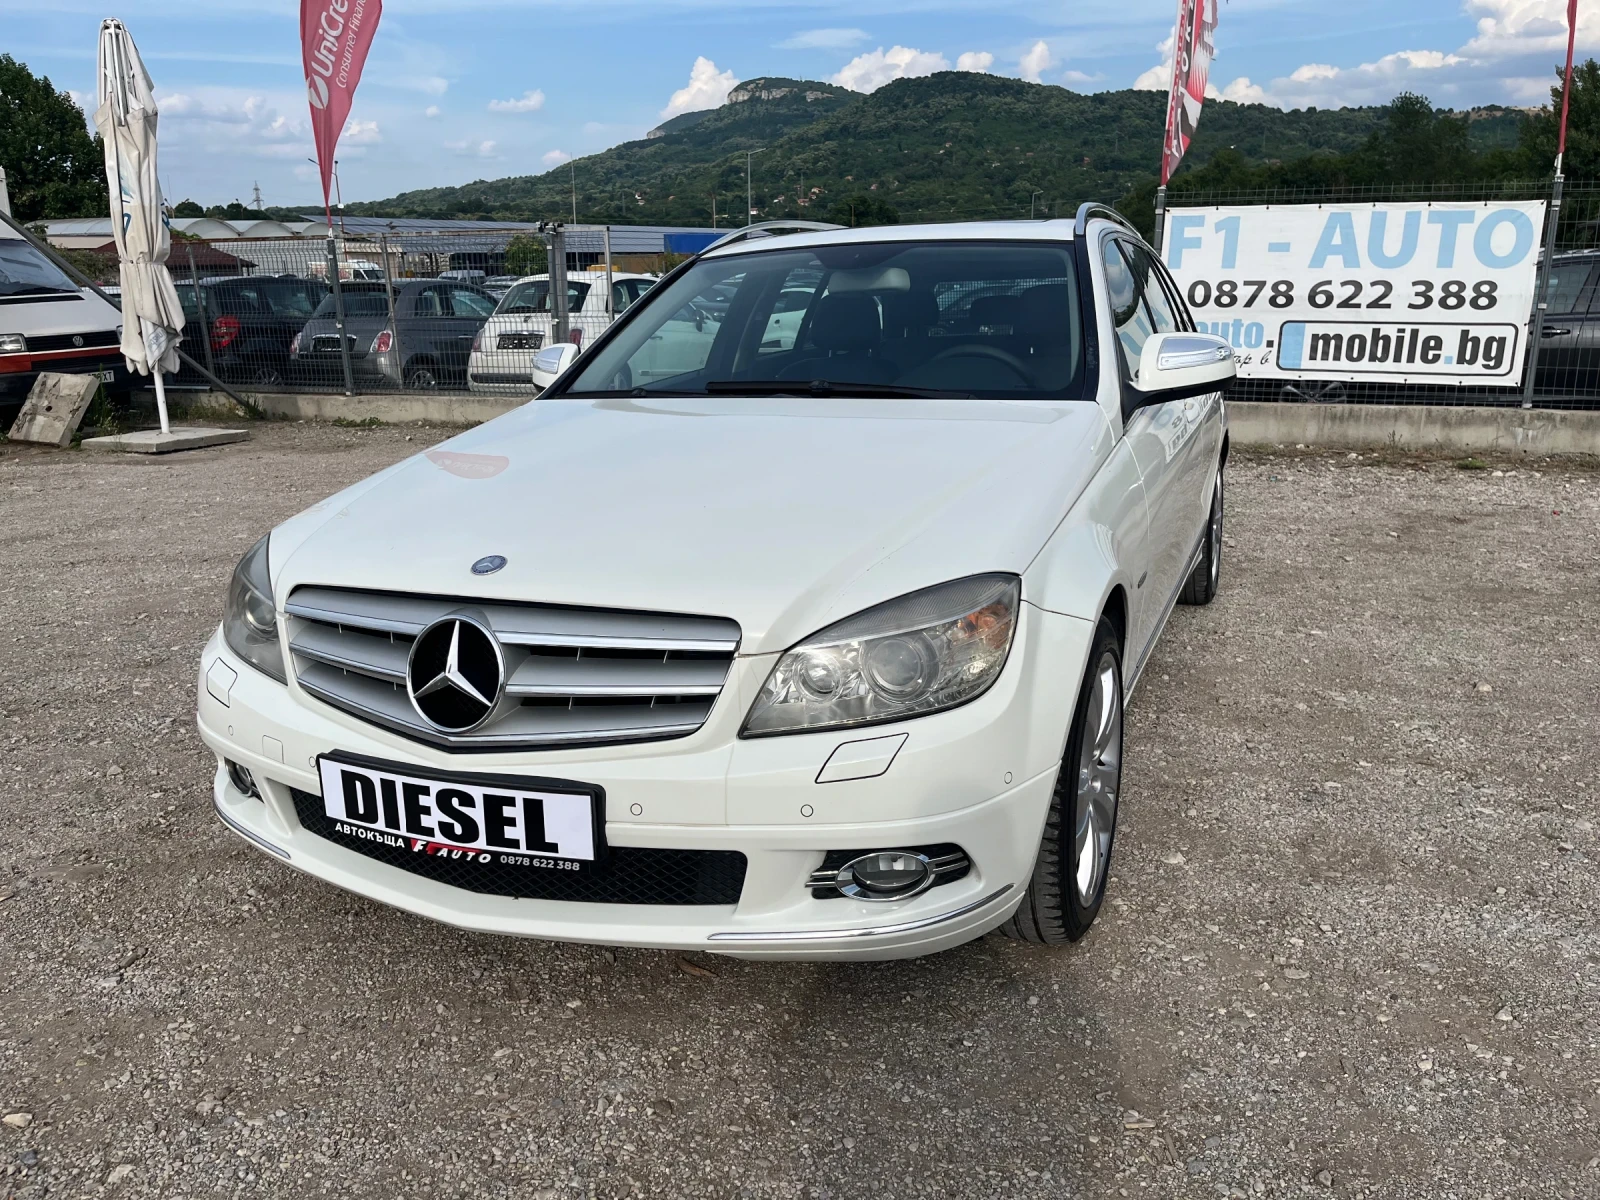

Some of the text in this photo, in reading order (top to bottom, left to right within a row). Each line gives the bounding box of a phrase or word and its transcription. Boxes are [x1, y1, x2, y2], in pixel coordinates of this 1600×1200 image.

[335, 0, 367, 88] Consumer Finan
[1167, 214, 1241, 270] F1
[1308, 208, 1535, 270] AUTO
[1187, 279, 1499, 311] 0878 622 388
[1308, 327, 1507, 370] mobile.bg
[340, 769, 559, 854] DIESEL
[334, 822, 406, 848] АВТОКЪЩА
[436, 847, 492, 864] AUTO
[500, 854, 581, 871] 0878 622 388
